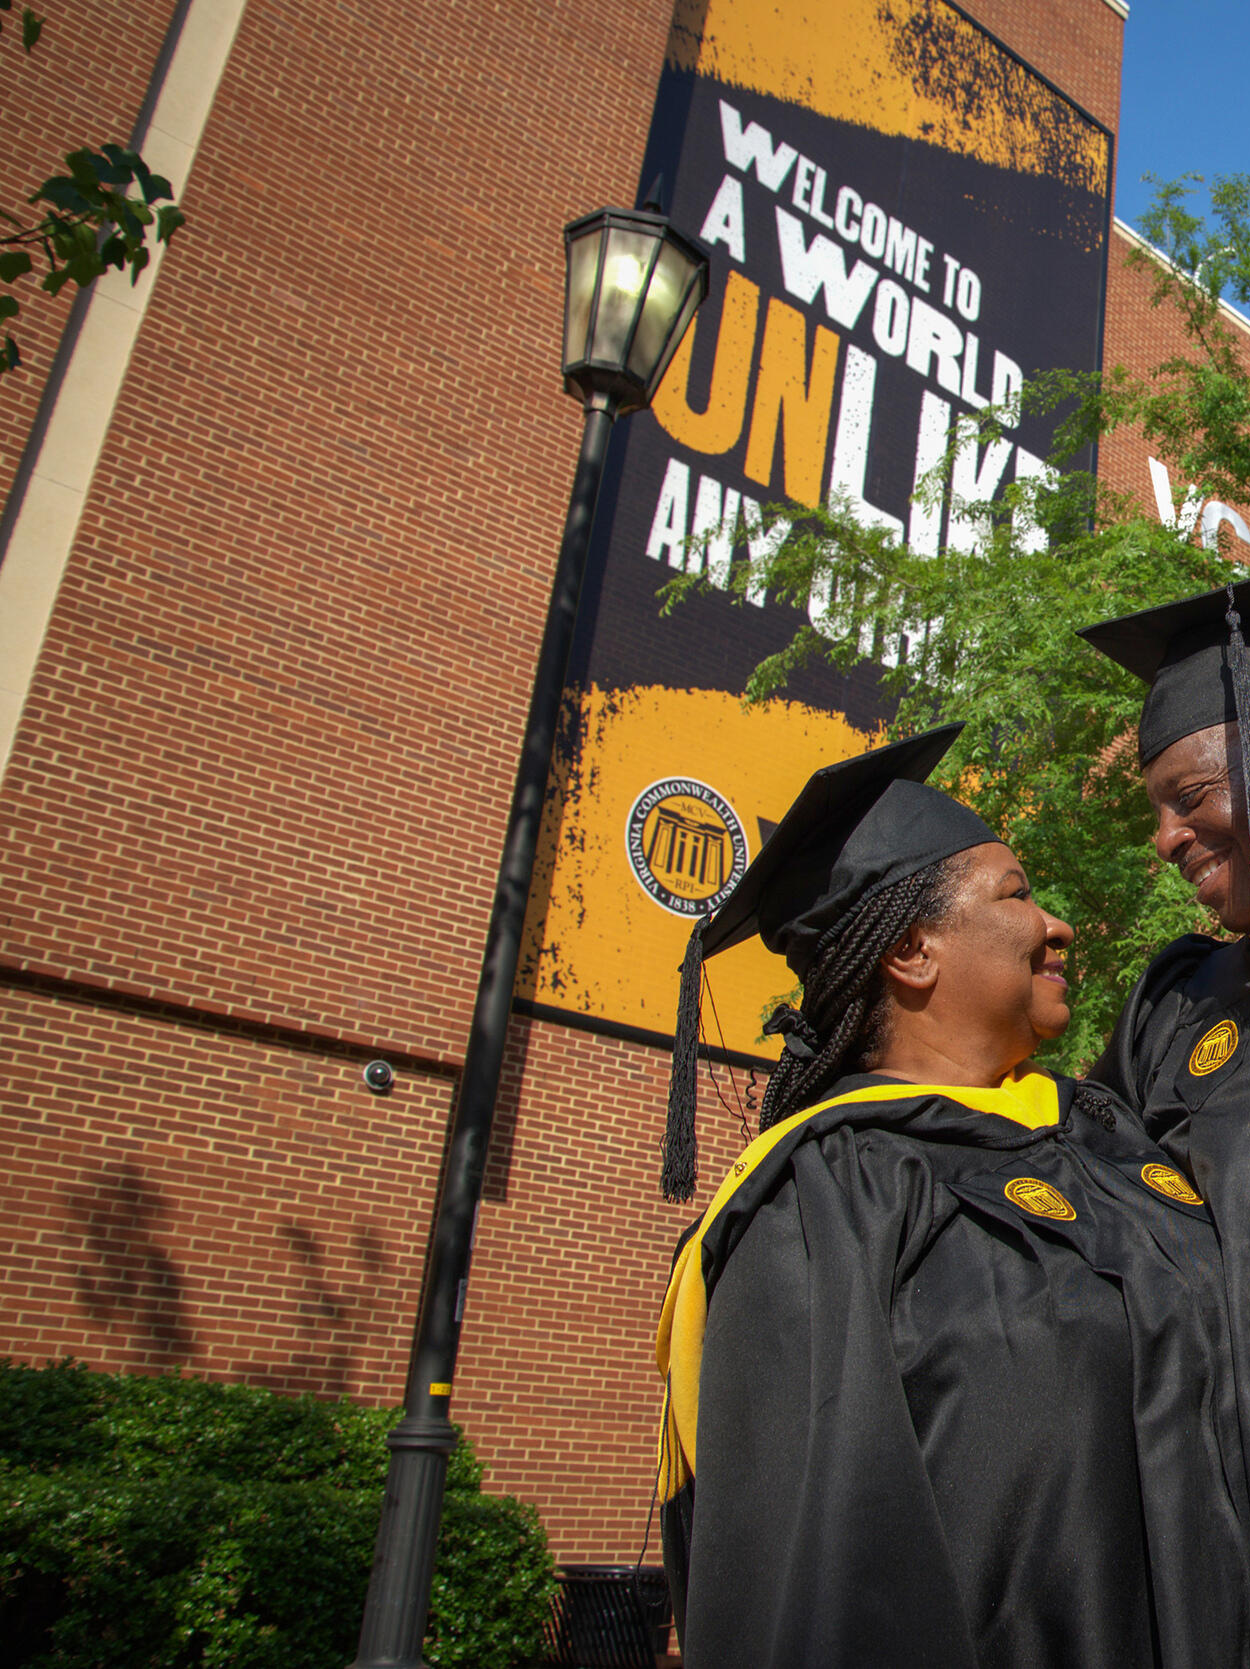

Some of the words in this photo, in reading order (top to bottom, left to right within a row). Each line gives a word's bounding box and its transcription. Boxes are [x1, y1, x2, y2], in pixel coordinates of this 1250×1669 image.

[719, 99, 934, 293] WELCOME
[943, 253, 982, 322] TO
[700, 174, 745, 263] A
[775, 206, 1023, 429] WORLD
[645, 457, 792, 608] ANY
[635, 782, 738, 832] COMMONWEALTH
[631, 823, 659, 894] VIRGINIA
[674, 878, 695, 893] RPI
[668, 895, 696, 913] 1838
